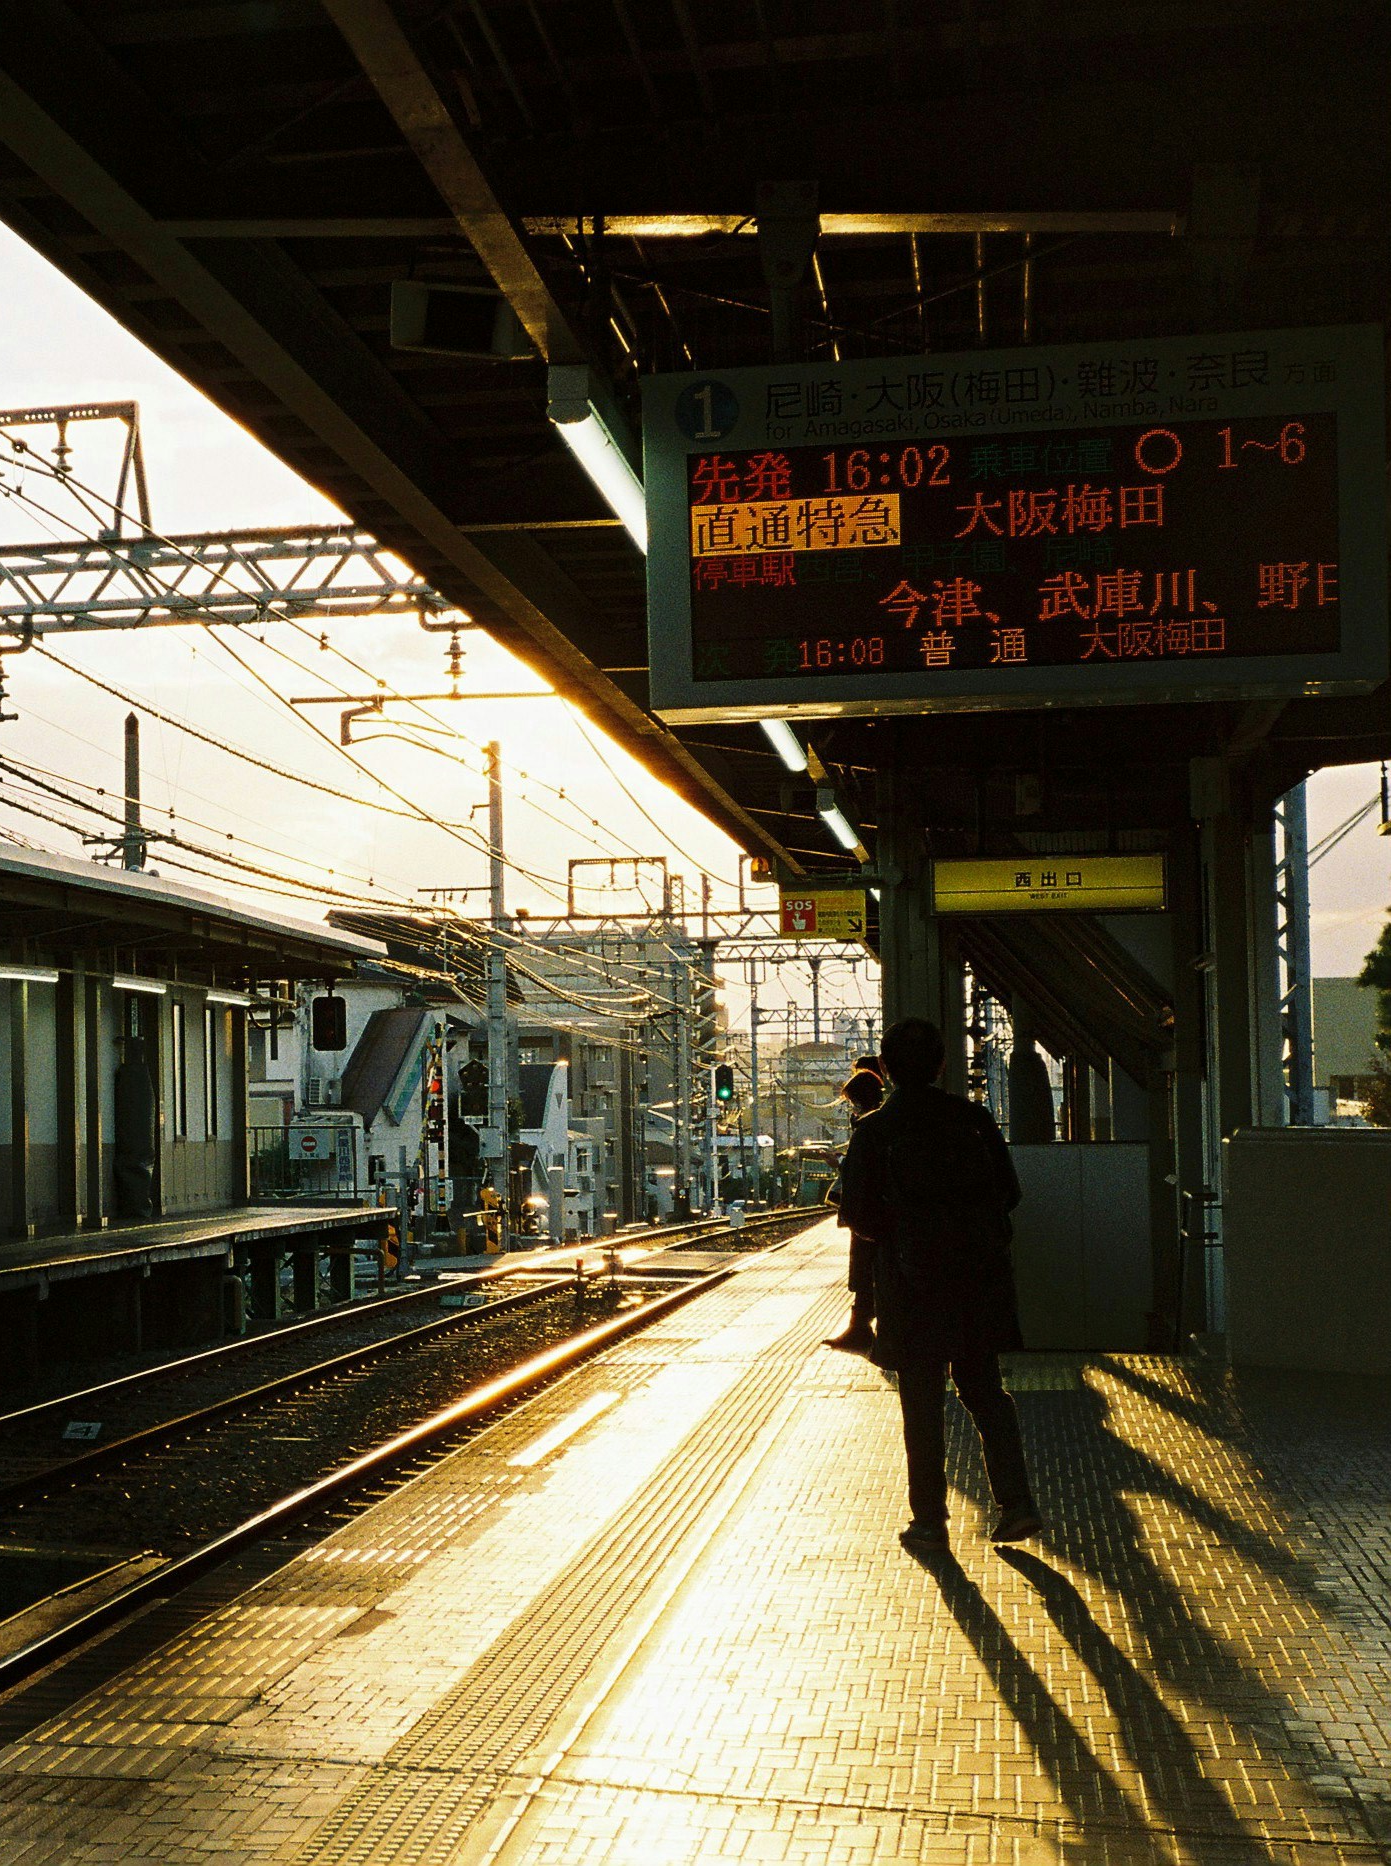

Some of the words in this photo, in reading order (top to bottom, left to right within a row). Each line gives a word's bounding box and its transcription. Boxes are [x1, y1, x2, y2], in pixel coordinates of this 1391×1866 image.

[1283, 358, 1337, 386] 方面
[693, 385, 722, 440] 1
[766, 421, 793, 441] for
[804, 412, 919, 439] Amagasaki,
[1084, 397, 1164, 420] Namba,
[1169, 395, 1218, 414] Nara
[691, 452, 793, 505] 先発
[821, 444, 952, 493] 16:02
[695, 496, 900, 554] 直通特急
[953, 483, 1165, 540] 大阪梅田
[692, 552, 797, 592] 停車駅
[879, 576, 1001, 629] 今津、
[1037, 568, 1219, 622] 武庫川、
[800, 636, 885, 669] 16:08
[1080, 618, 1226, 660] 大阪梅田
[1015, 871, 1082, 888] 西出口
[785, 900, 813, 911] SOS
